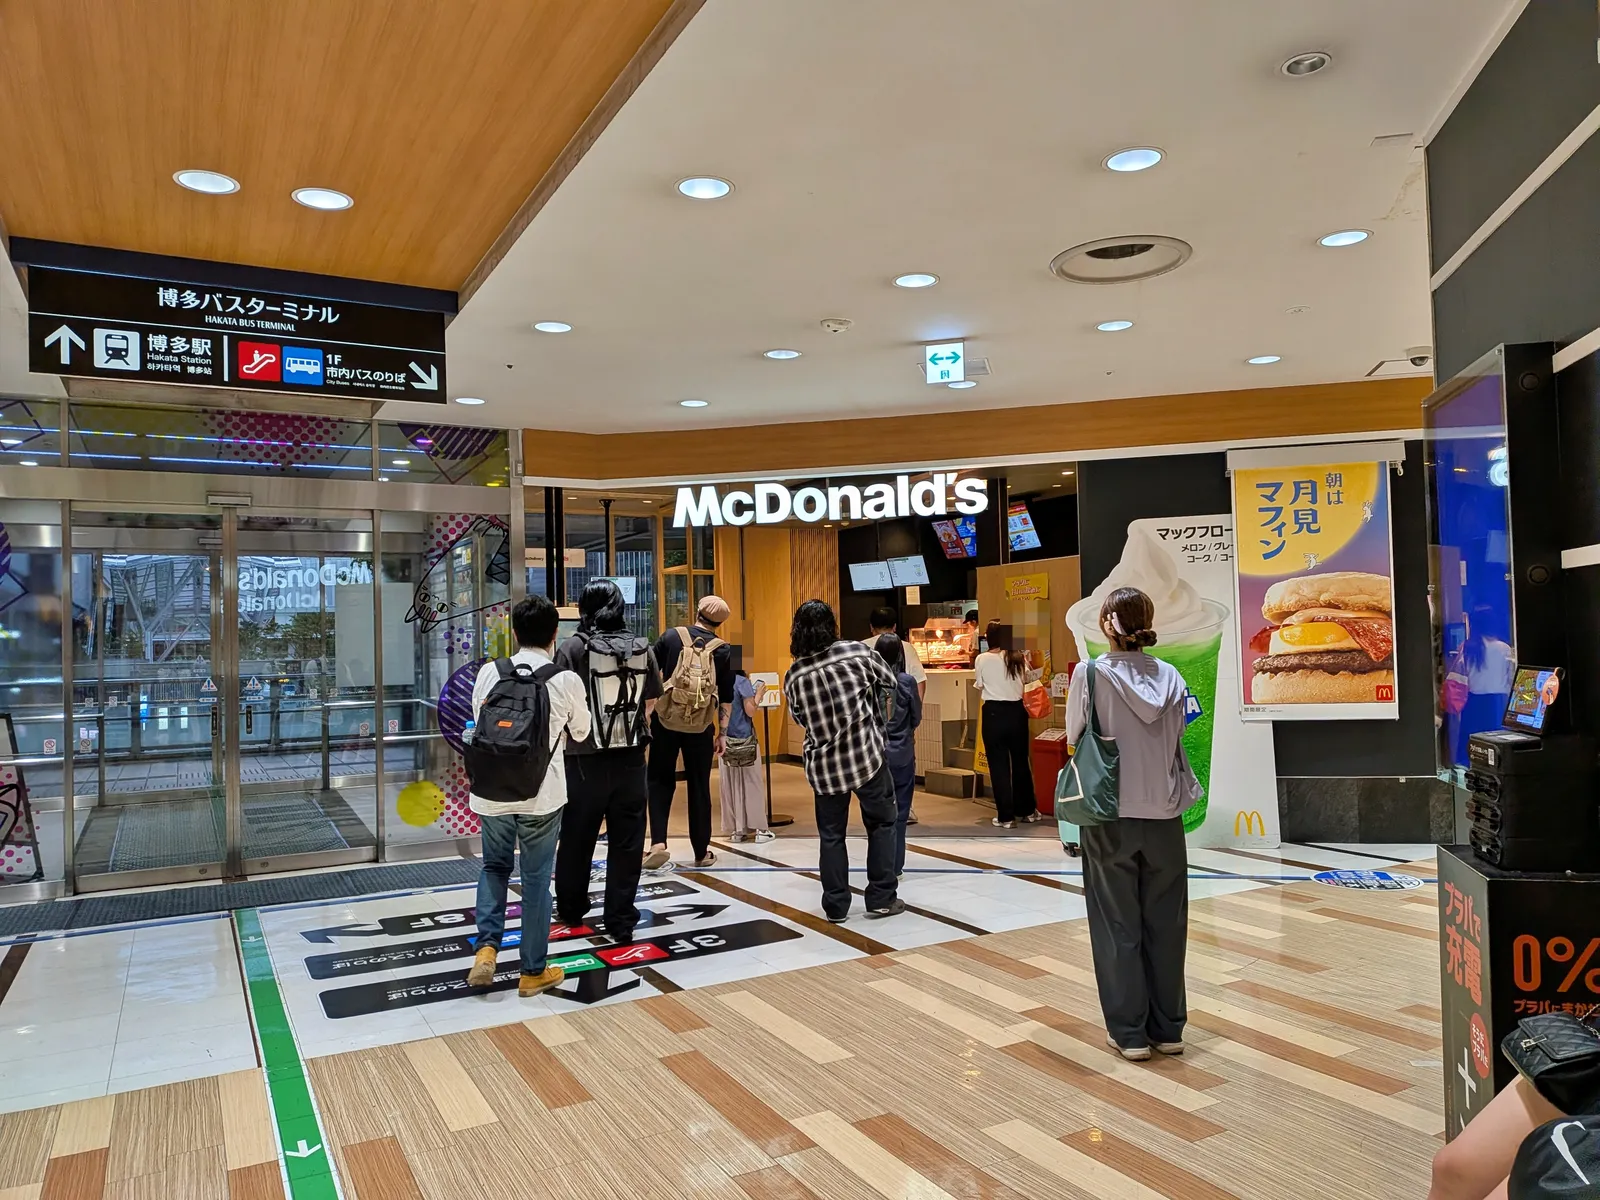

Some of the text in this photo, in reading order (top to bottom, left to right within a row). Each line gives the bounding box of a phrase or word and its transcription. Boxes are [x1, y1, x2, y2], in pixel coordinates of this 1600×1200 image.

[157, 286, 340, 324] 博多バスターミナル
[205, 315, 296, 331] HAKATA BUS TERMINAL
[147, 333, 212, 356] 博多駅
[146, 352, 212, 365] Hakata Station
[146, 363, 181, 373] 하카타역
[326, 354, 342, 366] 1F
[186, 365, 212, 376] 博多站
[326, 366, 406, 384] 市内バスのりば
[672, 472, 988, 528] McDonald's
[1325, 472, 1344, 505] 朝は
[1289, 479, 1321, 535] 月見
[1255, 481, 1287, 561] マフィン
[1181, 543, 1207, 553] メロン
[409, 913, 466, 929] 8F
[1444, 881, 1481, 944] プラパで
[668, 934, 727, 954] 3F
[332, 945, 463, 970] 市内バスのりば
[1446, 924, 1482, 1007] 充電
[1513, 934, 1600, 994] 0%
